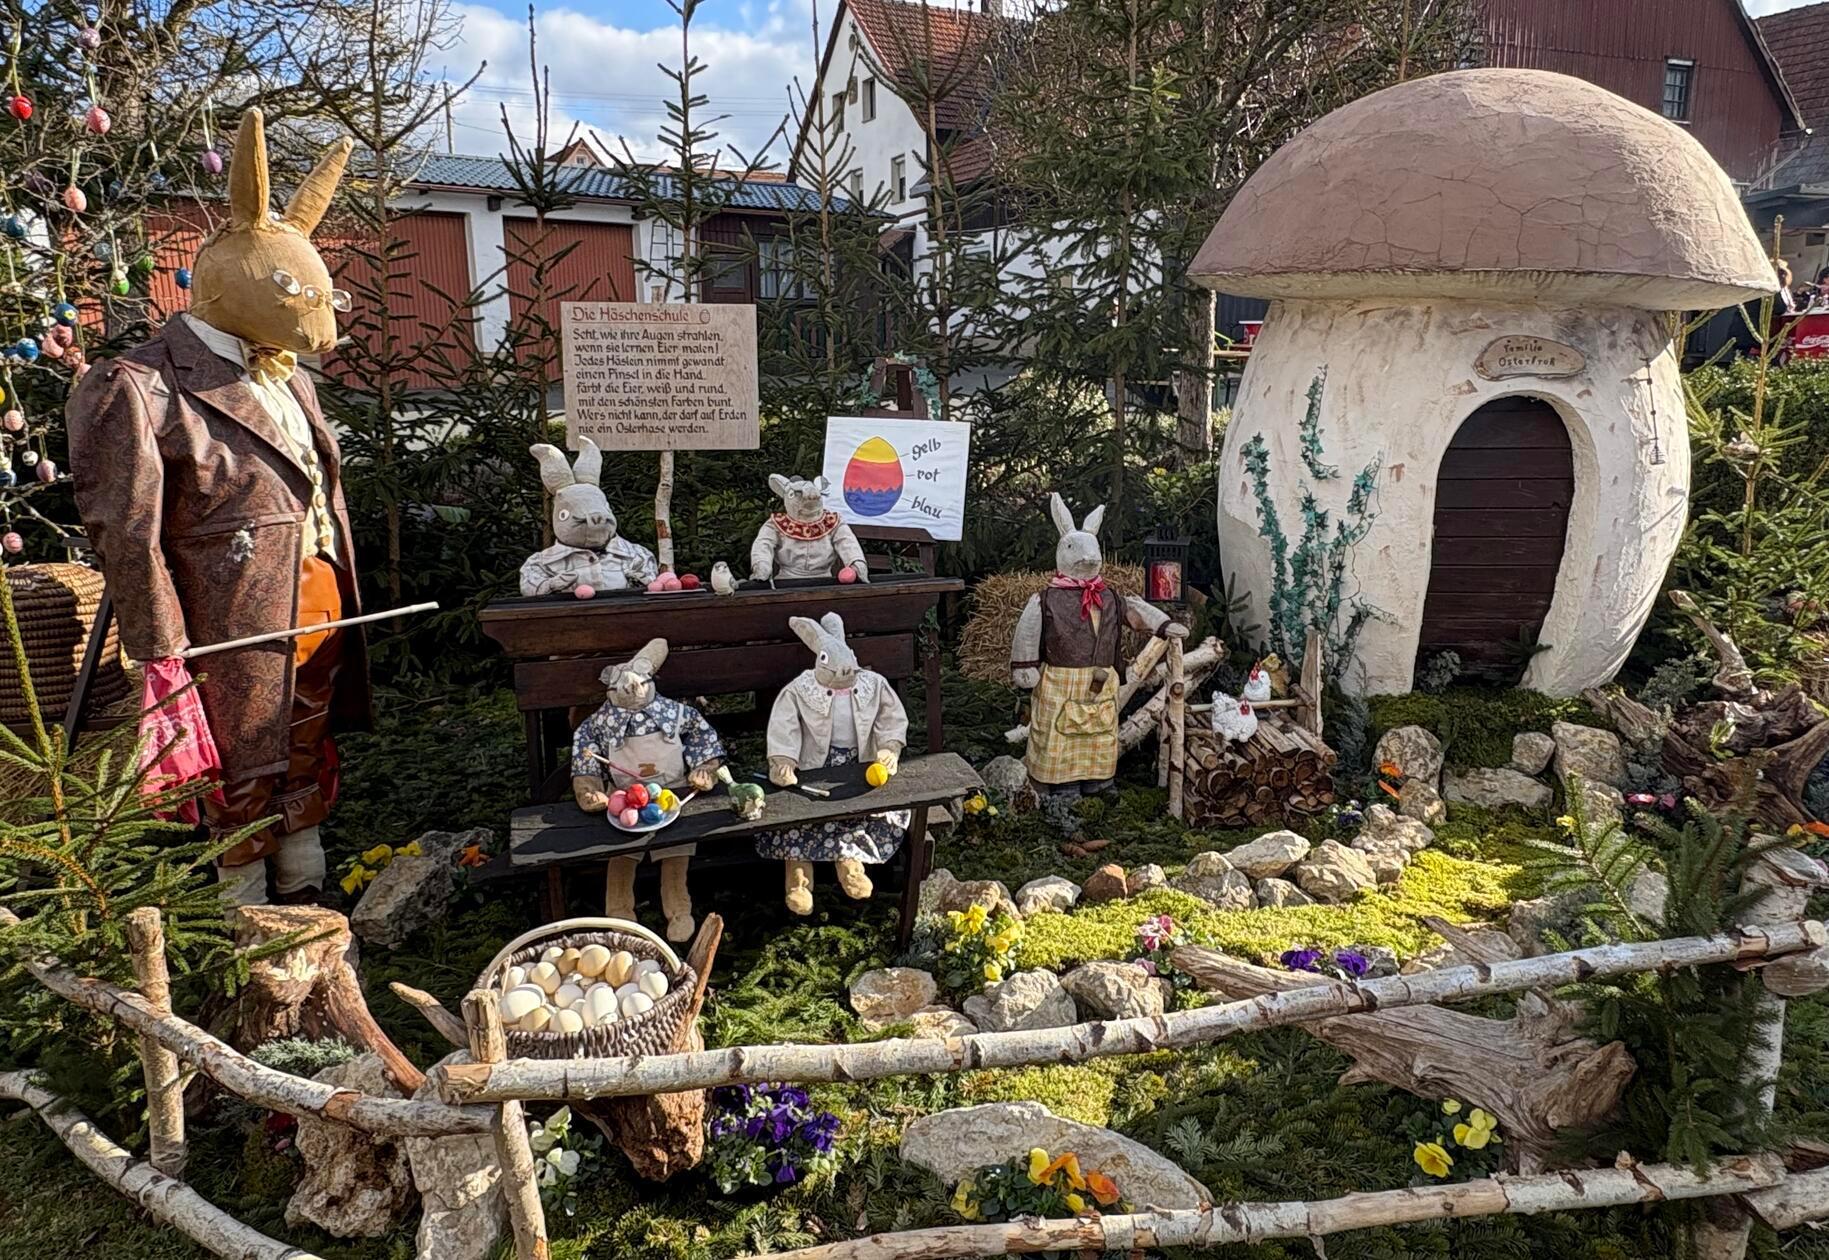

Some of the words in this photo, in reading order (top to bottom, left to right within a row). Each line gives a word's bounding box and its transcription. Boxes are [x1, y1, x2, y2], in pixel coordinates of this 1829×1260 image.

[571, 306, 597, 321] Die
[599, 306, 689, 322] Häschenschule
[599, 327, 618, 341] wie
[620, 328, 640, 341] ihre
[641, 328, 675, 341] Augen
[574, 343, 603, 353] wenn
[606, 342, 621, 353] sie
[621, 341, 655, 353] lernen
[657, 341, 679, 354] Eier
[681, 342, 719, 354] malen!
[573, 353, 605, 366] Jedes
[606, 354, 644, 366] Häslein
[646, 355, 680, 367] nimmt
[575, 368, 605, 380] einen
[608, 367, 640, 380] Pinsel
[642, 368, 653, 380] in
[654, 367, 671, 380] die
[576, 382, 602, 394] färbt
[604, 382, 620, 394] die
[646, 382, 672, 394] weiß
[675, 382, 695, 394] und
[578, 396, 596, 407] mit
[597, 396, 617, 407] den
[618, 395, 669, 408] schönsten
[671, 395, 704, 408] Farben
[608, 409, 632, 420] nicht
[661, 409, 678, 420] der
[679, 409, 699, 421] darf
[700, 409, 717, 421] auf
[719, 408, 747, 420] Erden
[578, 422, 595, 434] nie
[597, 422, 614, 434] ein
[616, 422, 667, 434] Osterhase
[911, 438, 941, 461] gelb
[917, 468, 941, 482] rot
[911, 496, 943, 519] blau
